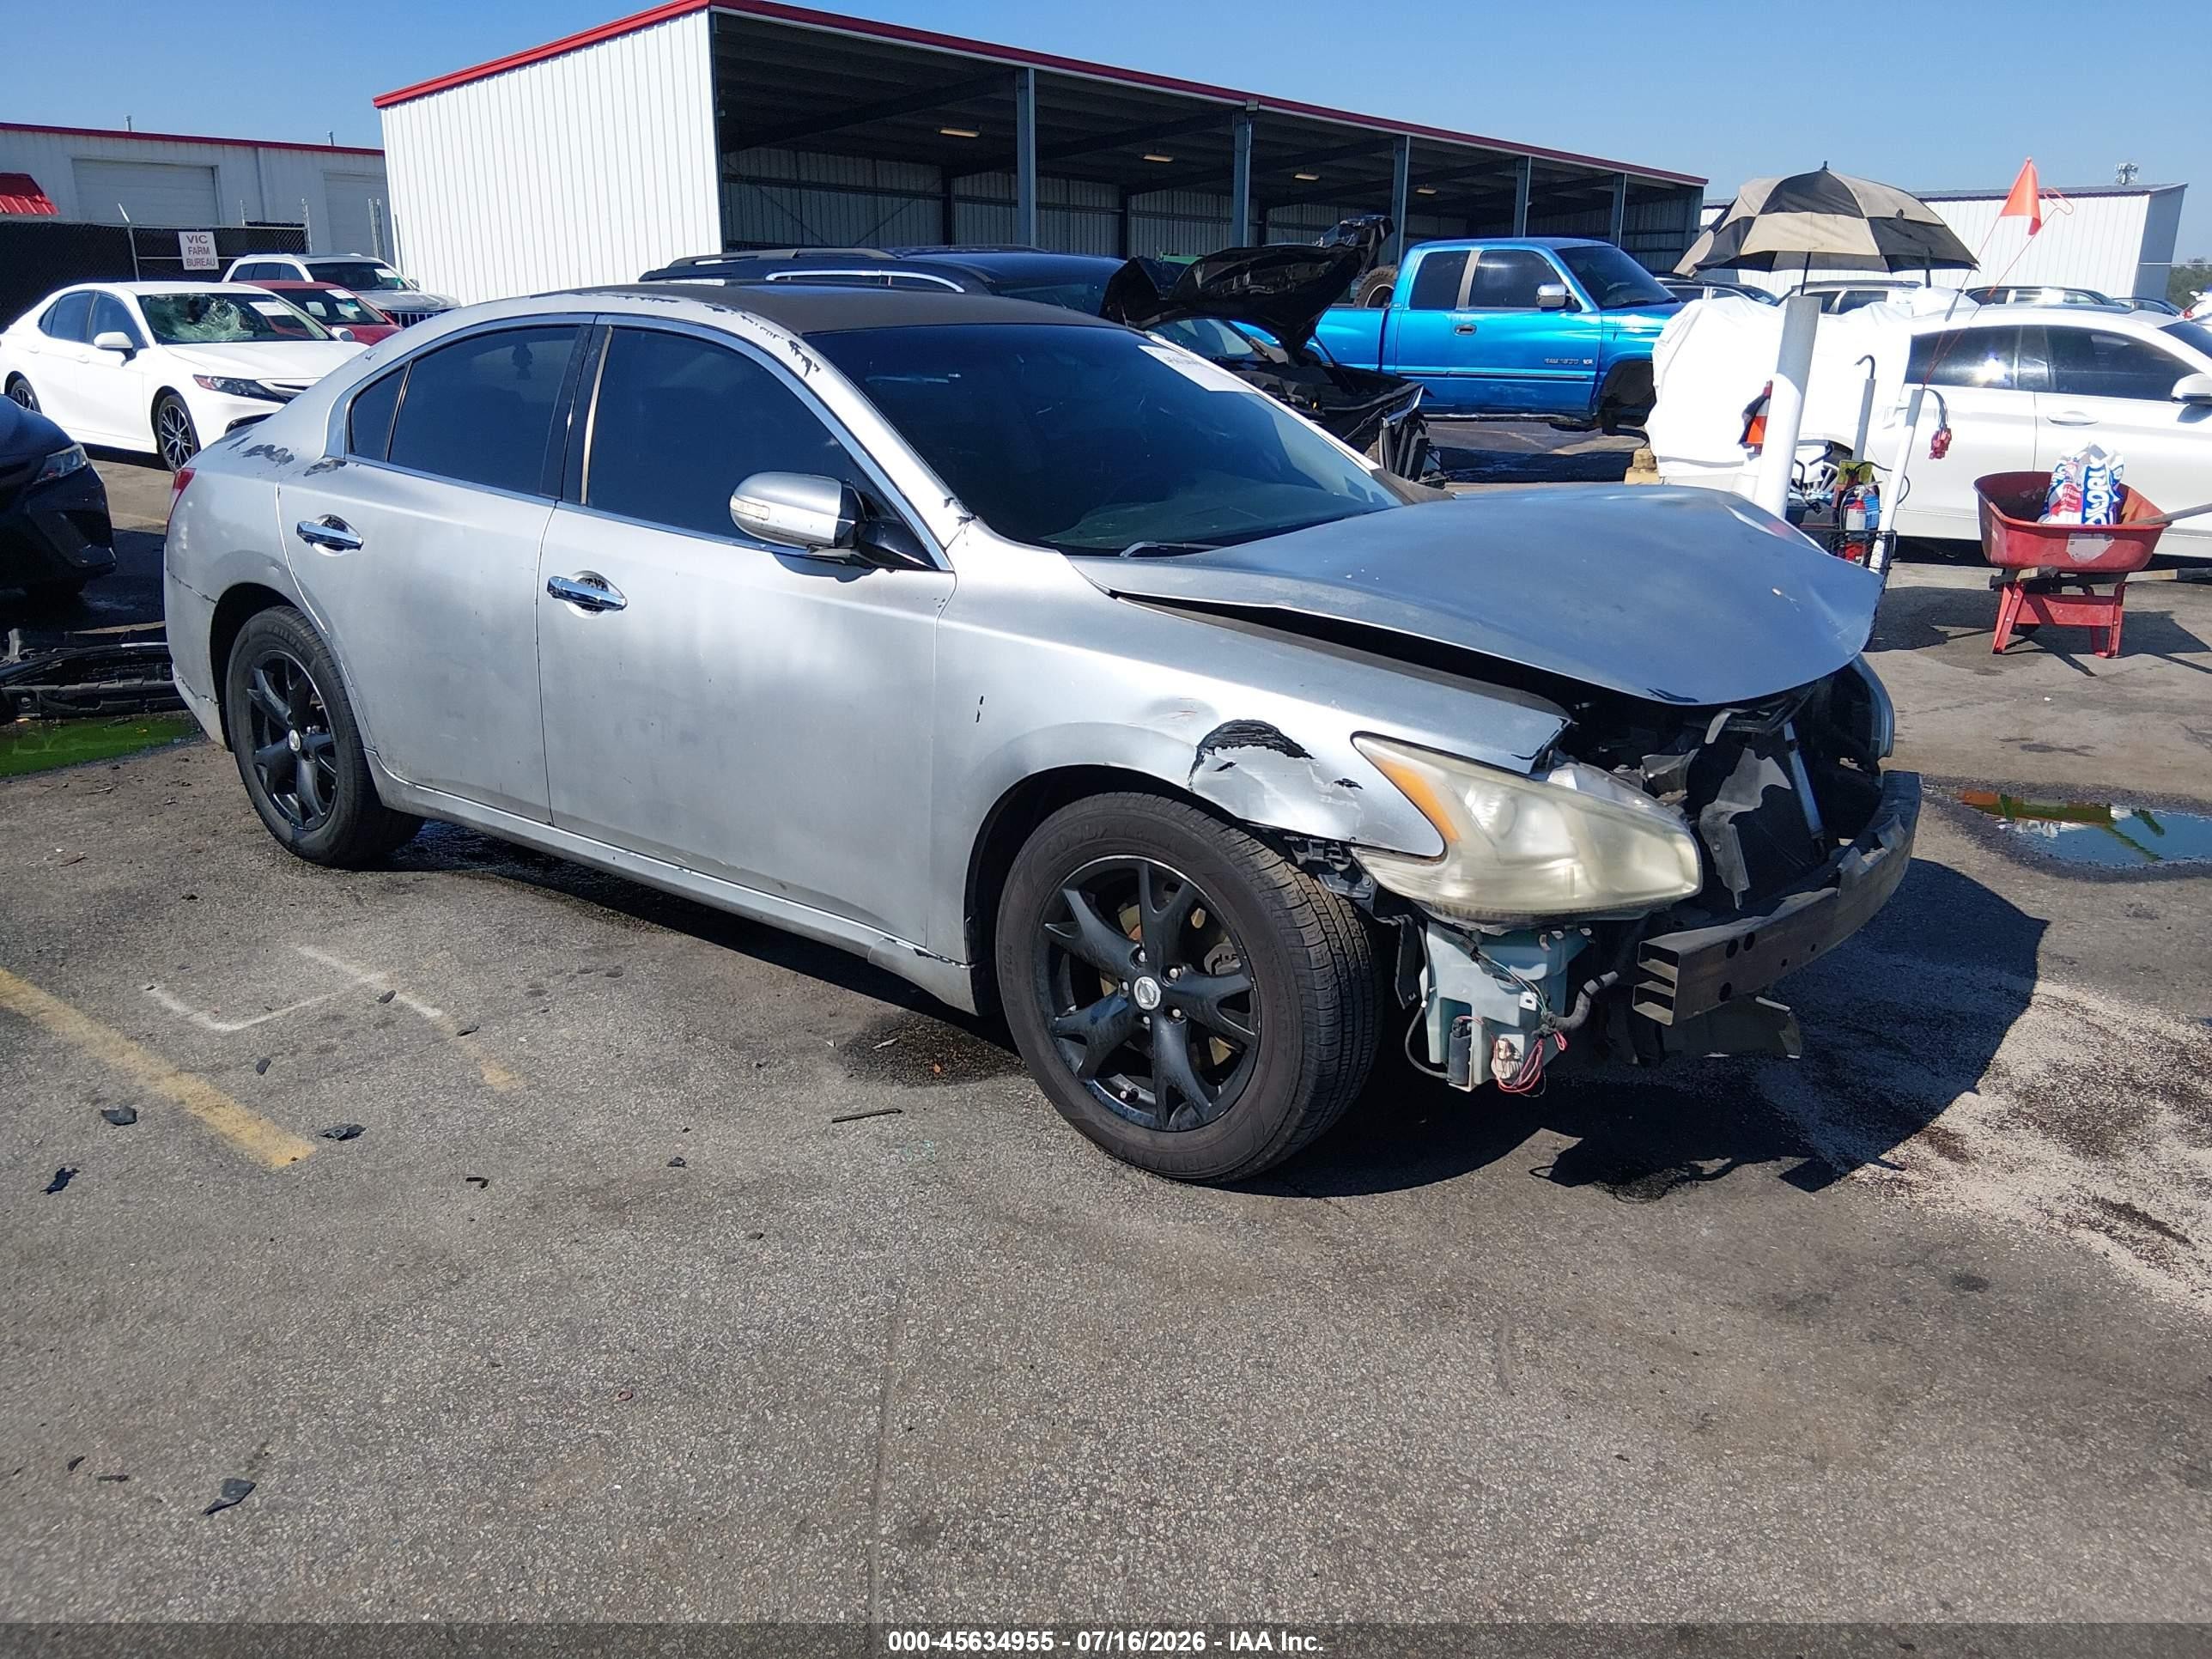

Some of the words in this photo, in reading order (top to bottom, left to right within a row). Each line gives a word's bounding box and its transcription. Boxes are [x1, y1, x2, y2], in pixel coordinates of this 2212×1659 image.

[185, 234, 208, 244] VIC
[187, 246, 210, 255] FARM
[185, 258, 216, 267] BUREAU
